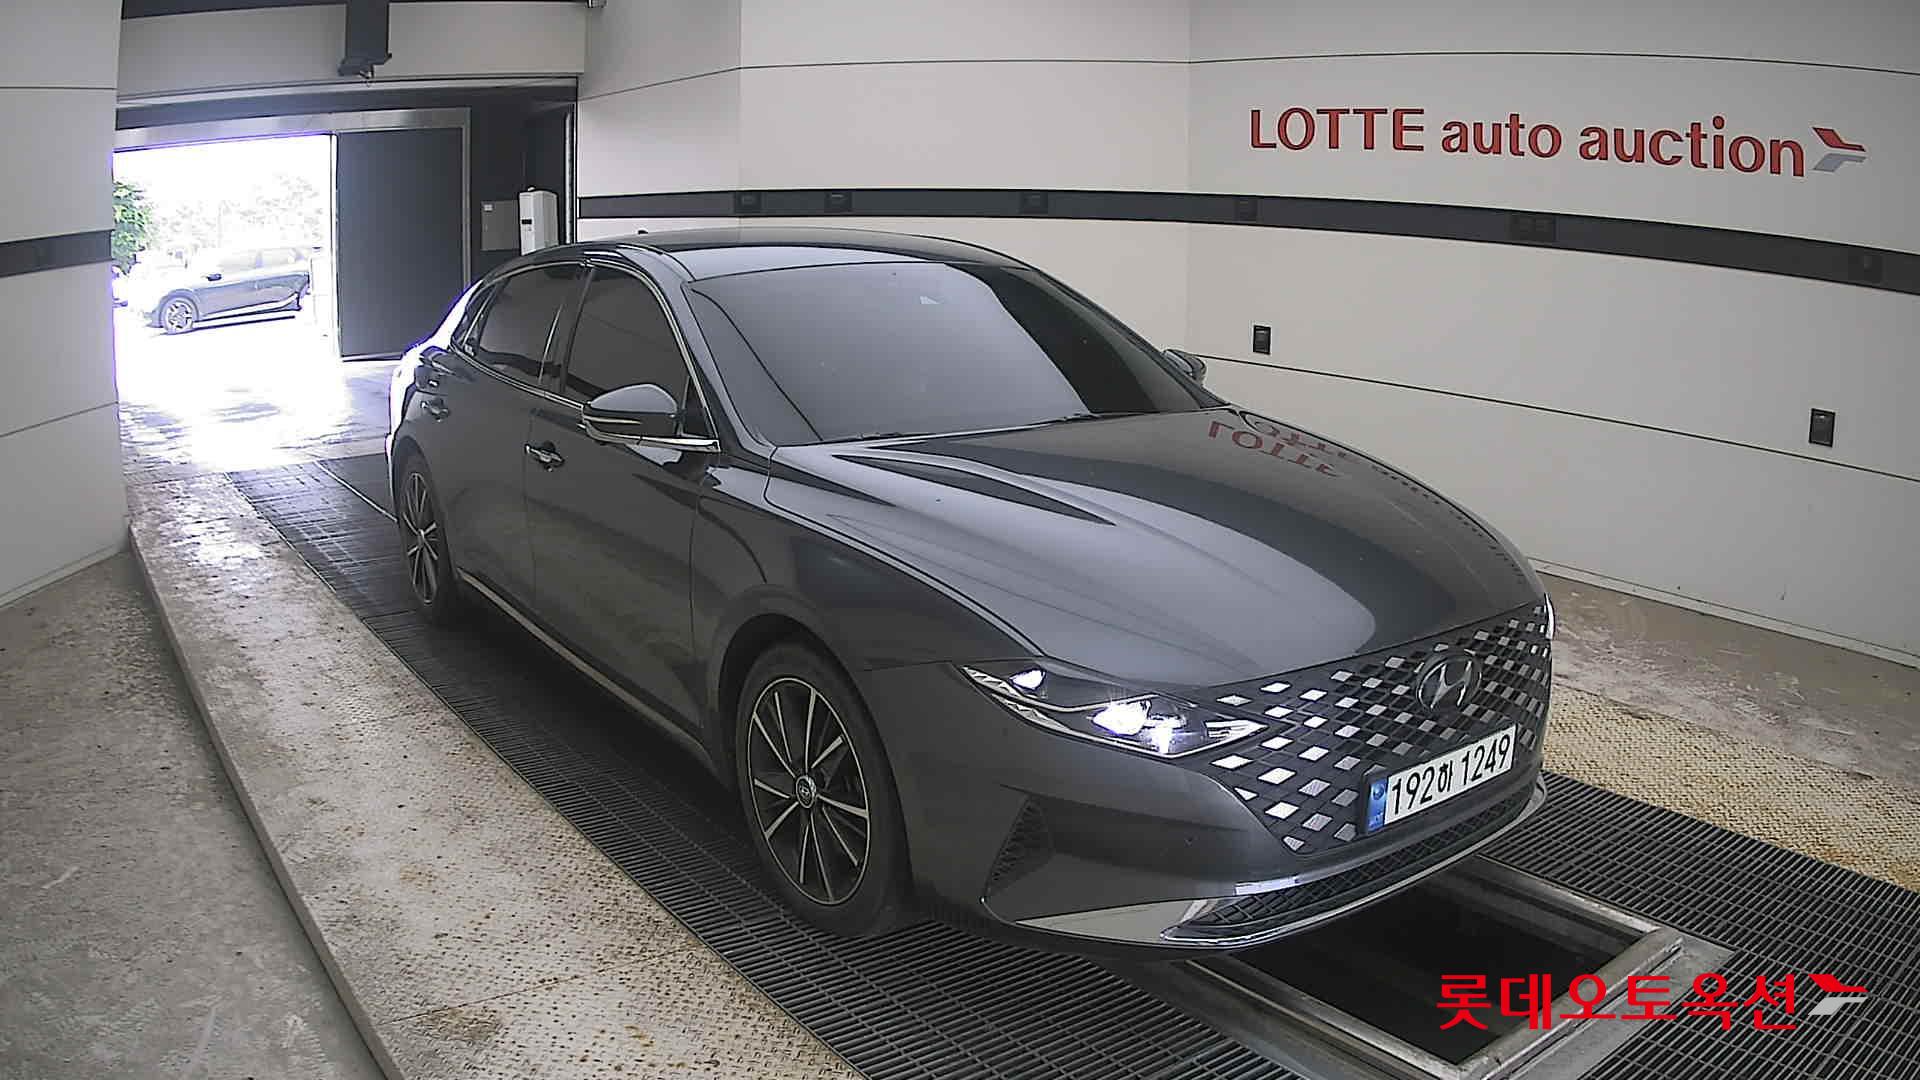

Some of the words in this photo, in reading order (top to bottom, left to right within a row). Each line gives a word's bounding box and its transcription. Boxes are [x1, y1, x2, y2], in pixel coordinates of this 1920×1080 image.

[1251, 107, 1425, 152] LOTTE
[1440, 112, 1562, 158] auto
[1578, 115, 1805, 177] auction
[1391, 760, 1453, 815] 192하
[1461, 734, 1511, 786] 1249
